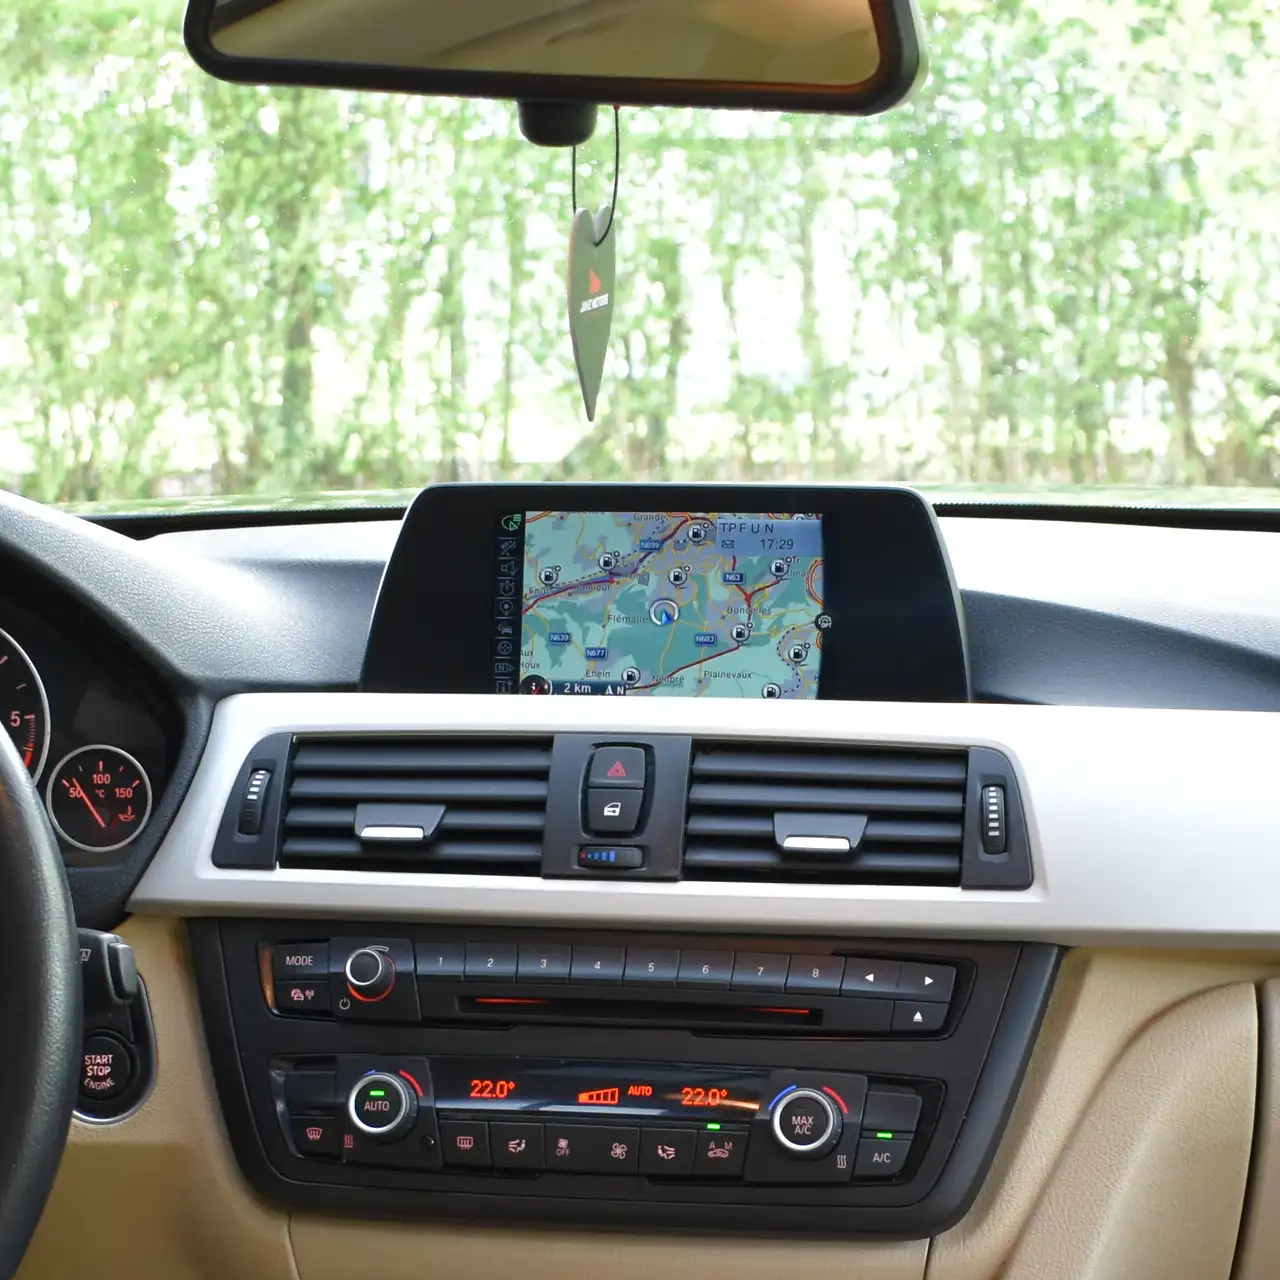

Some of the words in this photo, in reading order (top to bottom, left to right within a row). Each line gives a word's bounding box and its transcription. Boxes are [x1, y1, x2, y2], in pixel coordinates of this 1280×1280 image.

[760, 539, 794, 550] 17:29
[725, 573, 741, 582] N63
[550, 634, 570, 642] N639
[695, 635, 715, 643] N683
[586, 649, 606, 658] N677
[704, 669, 752, 679] Plainevaux
[564, 683, 571, 693] 2
[574, 683, 592, 693] km
[10, 710, 21, 727] 5
[92, 773, 111, 784] 100
[69, 787, 83, 798] 50
[114, 787, 133, 798] 150
[285, 955, 313, 966] MODE
[438, 956, 444, 966] 1
[487, 958, 494, 968] 2
[540, 958, 547, 969] 3
[594, 960, 601, 970] 4
[648, 962, 655, 972] 5
[702, 964, 710, 974] 6
[757, 966, 764, 976] 7
[812, 968, 819, 979] 8
[84, 1054, 114, 1065] START
[86, 1065, 112, 1076] STOP
[83, 1078, 115, 1090] ENGINE
[628, 1084, 653, 1096] AUTO
[364, 1100, 390, 1111] AUTO
[791, 1116, 814, 1125] MAX
[794, 1125, 812, 1135] A/C
[556, 1147, 570, 1156] OFF
[872, 1153, 891, 1163] A/C
